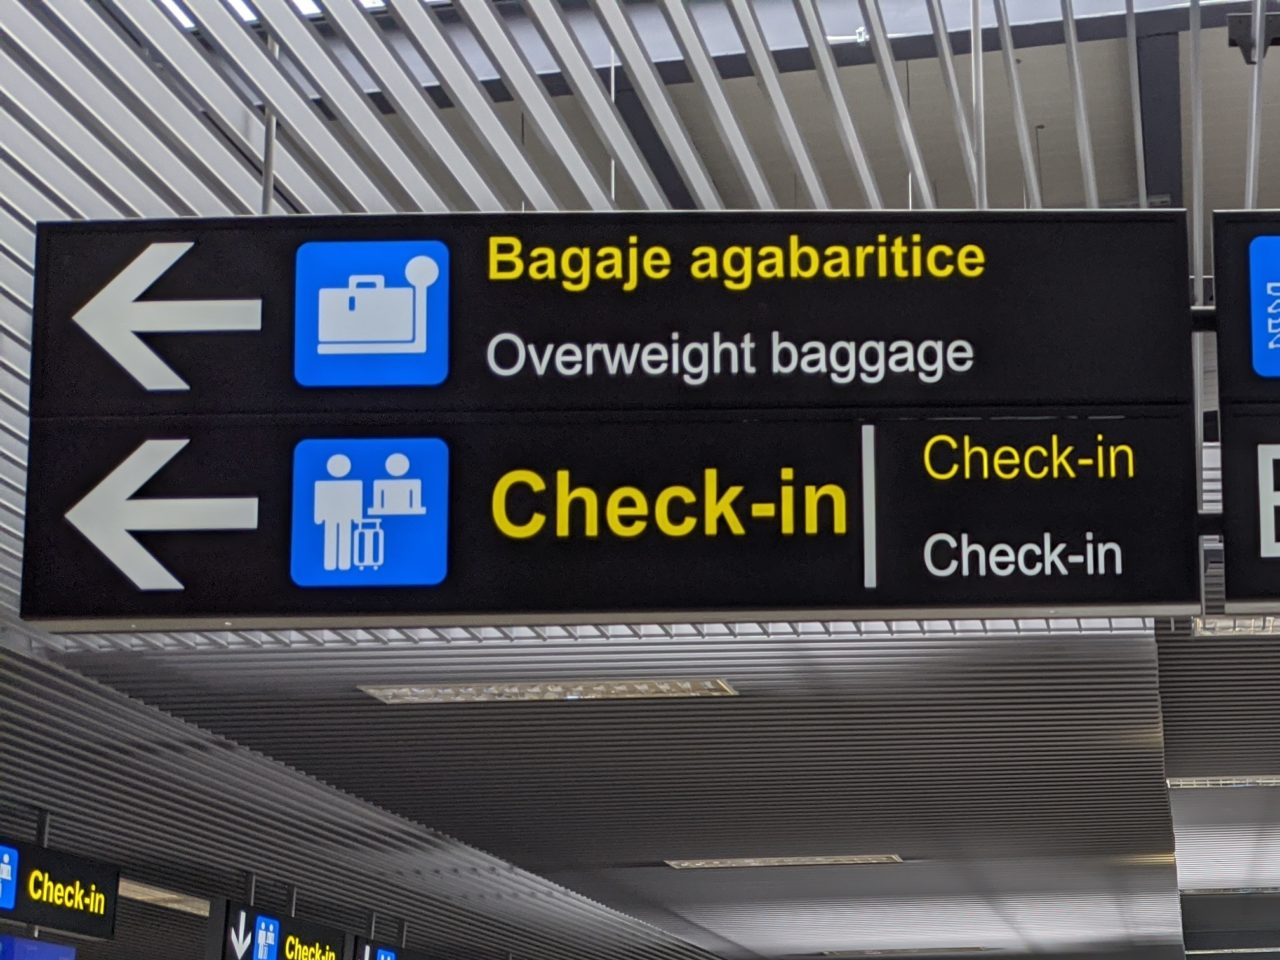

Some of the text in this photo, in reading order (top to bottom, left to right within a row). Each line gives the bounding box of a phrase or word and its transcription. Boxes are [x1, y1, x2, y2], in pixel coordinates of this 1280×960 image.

[489, 234, 986, 292] Bagaje agabaritice
[486, 331, 974, 386] Overweight baggage
[923, 433, 1135, 480] Check-in
[491, 467, 847, 540] Check-in
[923, 531, 1123, 577] Check-in
[27, 868, 106, 916] Check-in
